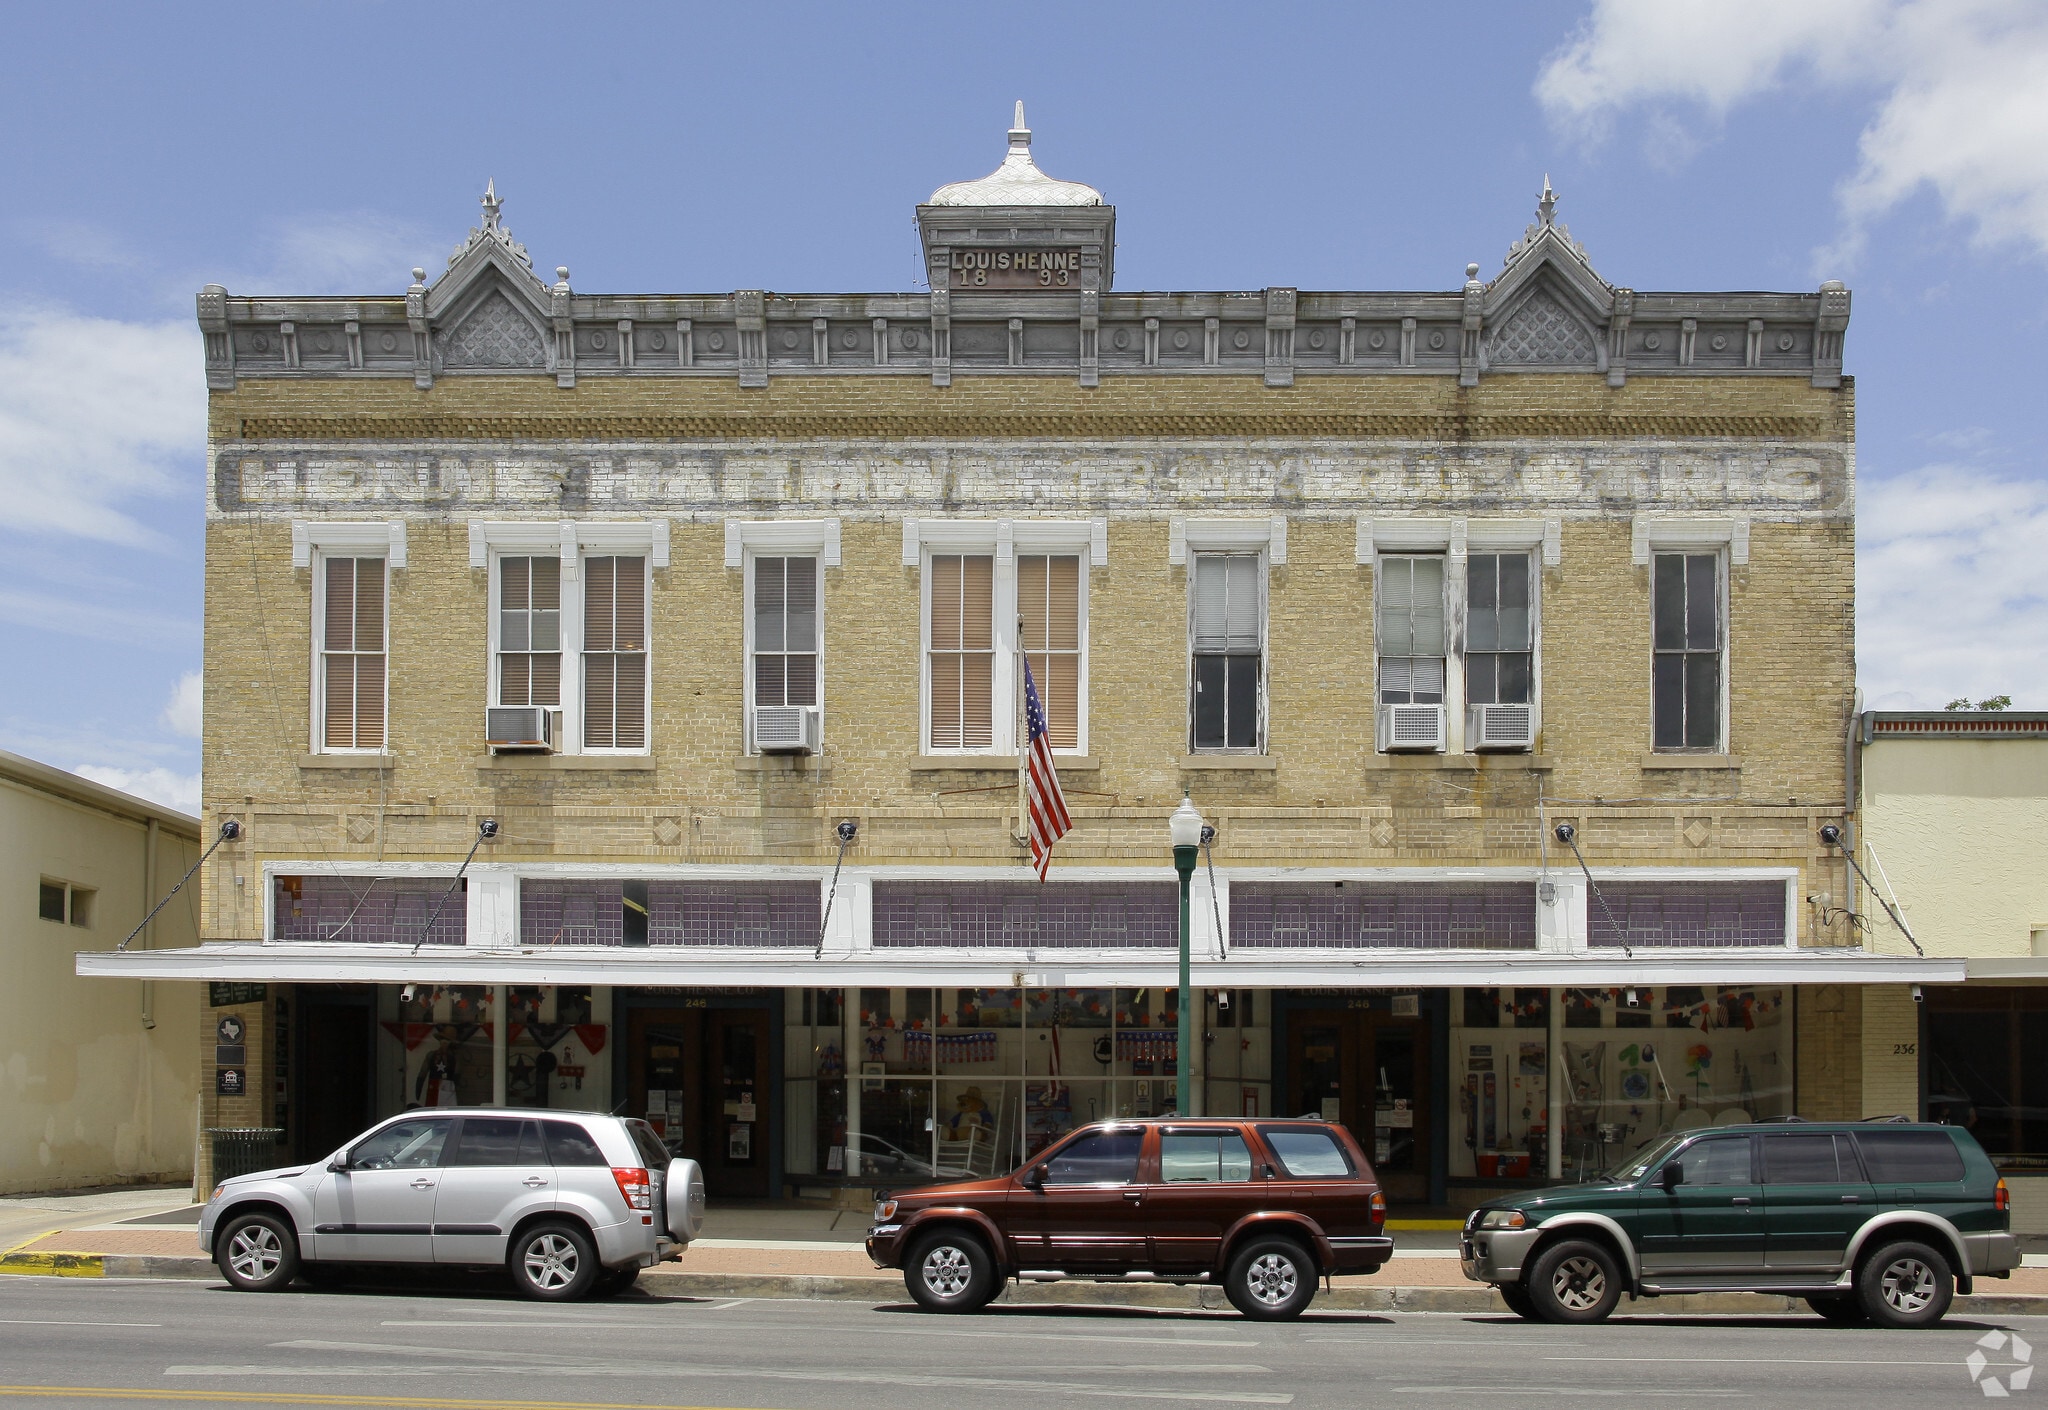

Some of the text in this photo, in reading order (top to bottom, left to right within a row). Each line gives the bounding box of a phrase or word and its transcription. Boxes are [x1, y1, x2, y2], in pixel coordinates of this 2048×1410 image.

[951, 252, 1079, 270] LOUIS HENNE
[960, 269, 1068, 286] 18 93
[685, 998, 708, 1008] 246
[1893, 1043, 1915, 1055] 236
